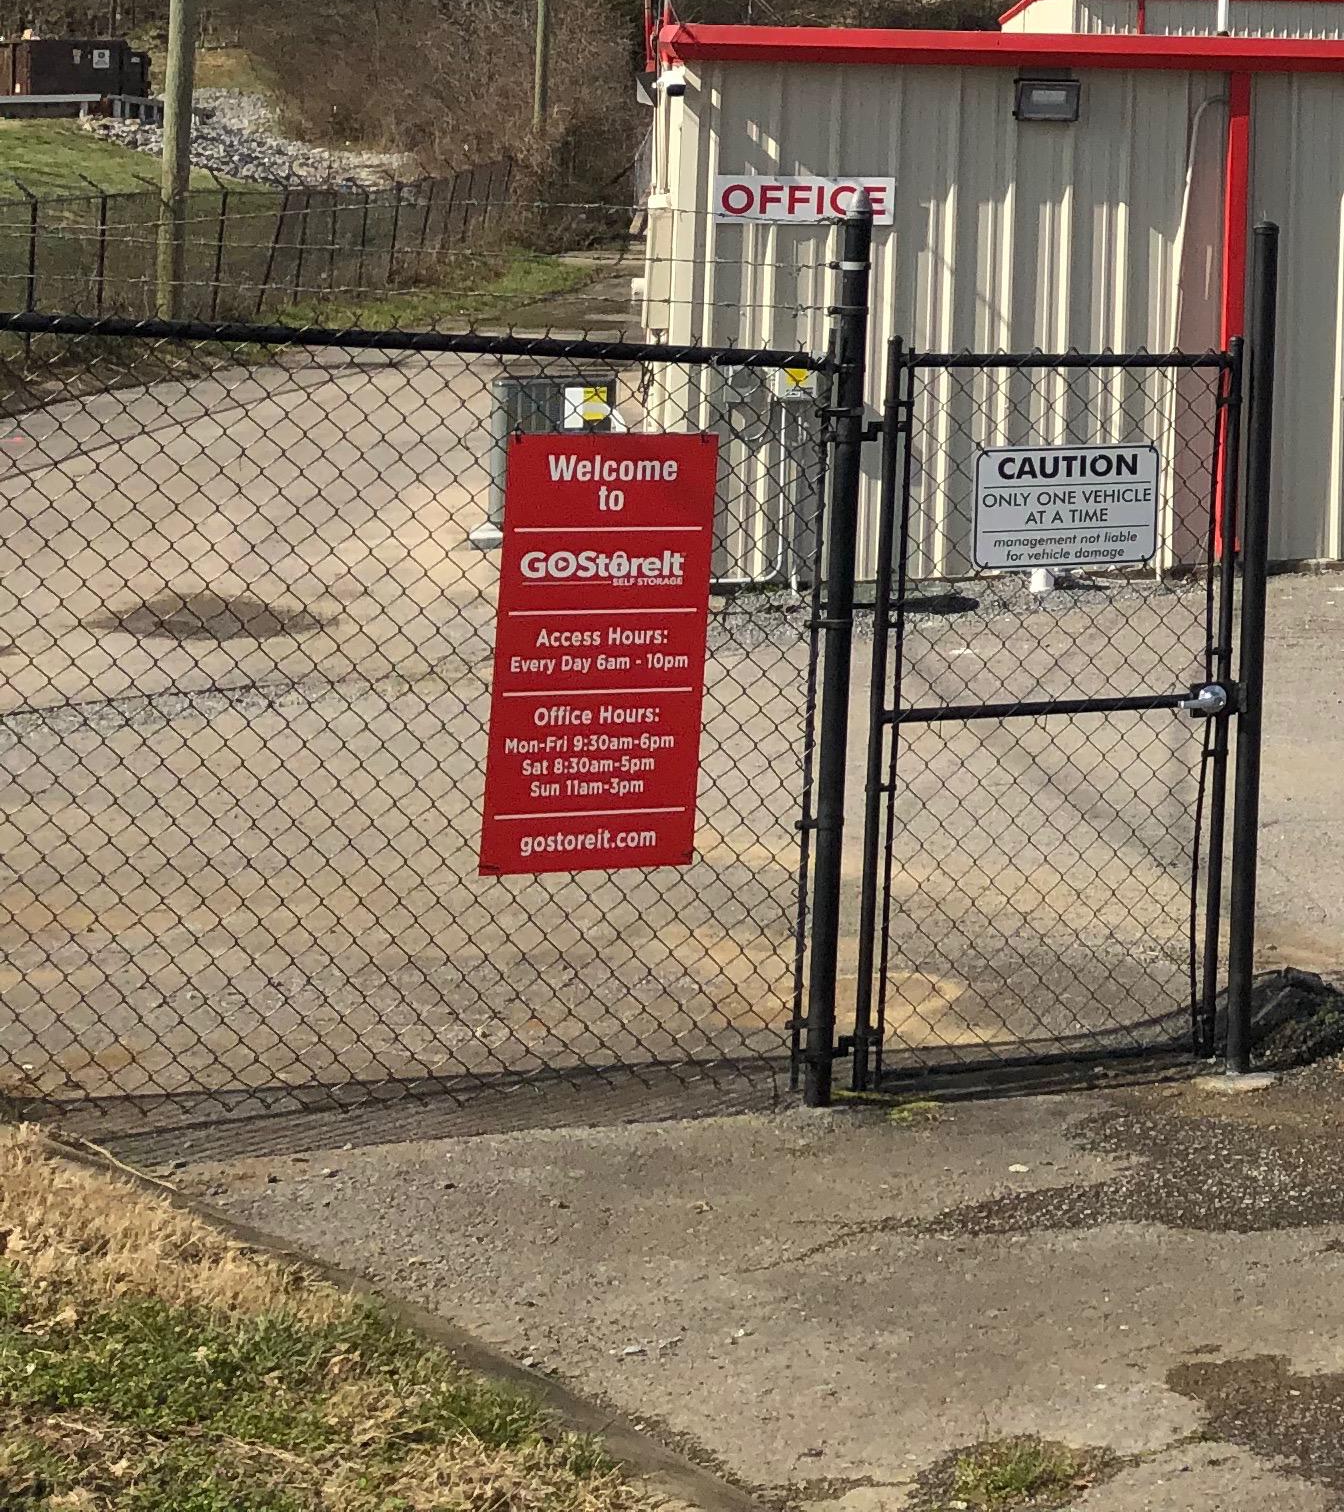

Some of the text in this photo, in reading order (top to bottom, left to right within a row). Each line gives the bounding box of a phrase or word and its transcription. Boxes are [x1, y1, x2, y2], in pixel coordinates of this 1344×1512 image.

[721, 184, 888, 216] OFFICE
[548, 454, 678, 481] Welcome
[997, 453, 1138, 480] CAUTION
[599, 486, 625, 512] to
[982, 488, 1152, 508] ONLY ONE VEHICLE
[1025, 508, 1108, 525] AT A TIME
[994, 531, 1138, 549] management not liable
[1006, 548, 1125, 562] for vehicle damage
[612, 577, 683, 586] SELF STORAGE
[536, 628, 668, 647] Access Hours:
[510, 656, 555, 674] Every
[561, 655, 592, 673] Day
[596, 655, 630, 671] 6am
[646, 653, 688, 672] 10pm
[534, 706, 660, 726] Office Hours:
[505, 734, 675, 754] Mon-Fri 9:30am-6pm
[522, 757, 655, 775] Sat 8:30am-5pm
[530, 779, 644, 797] Sun 11am-3pm
[520, 827, 657, 857] gostoreit.com
